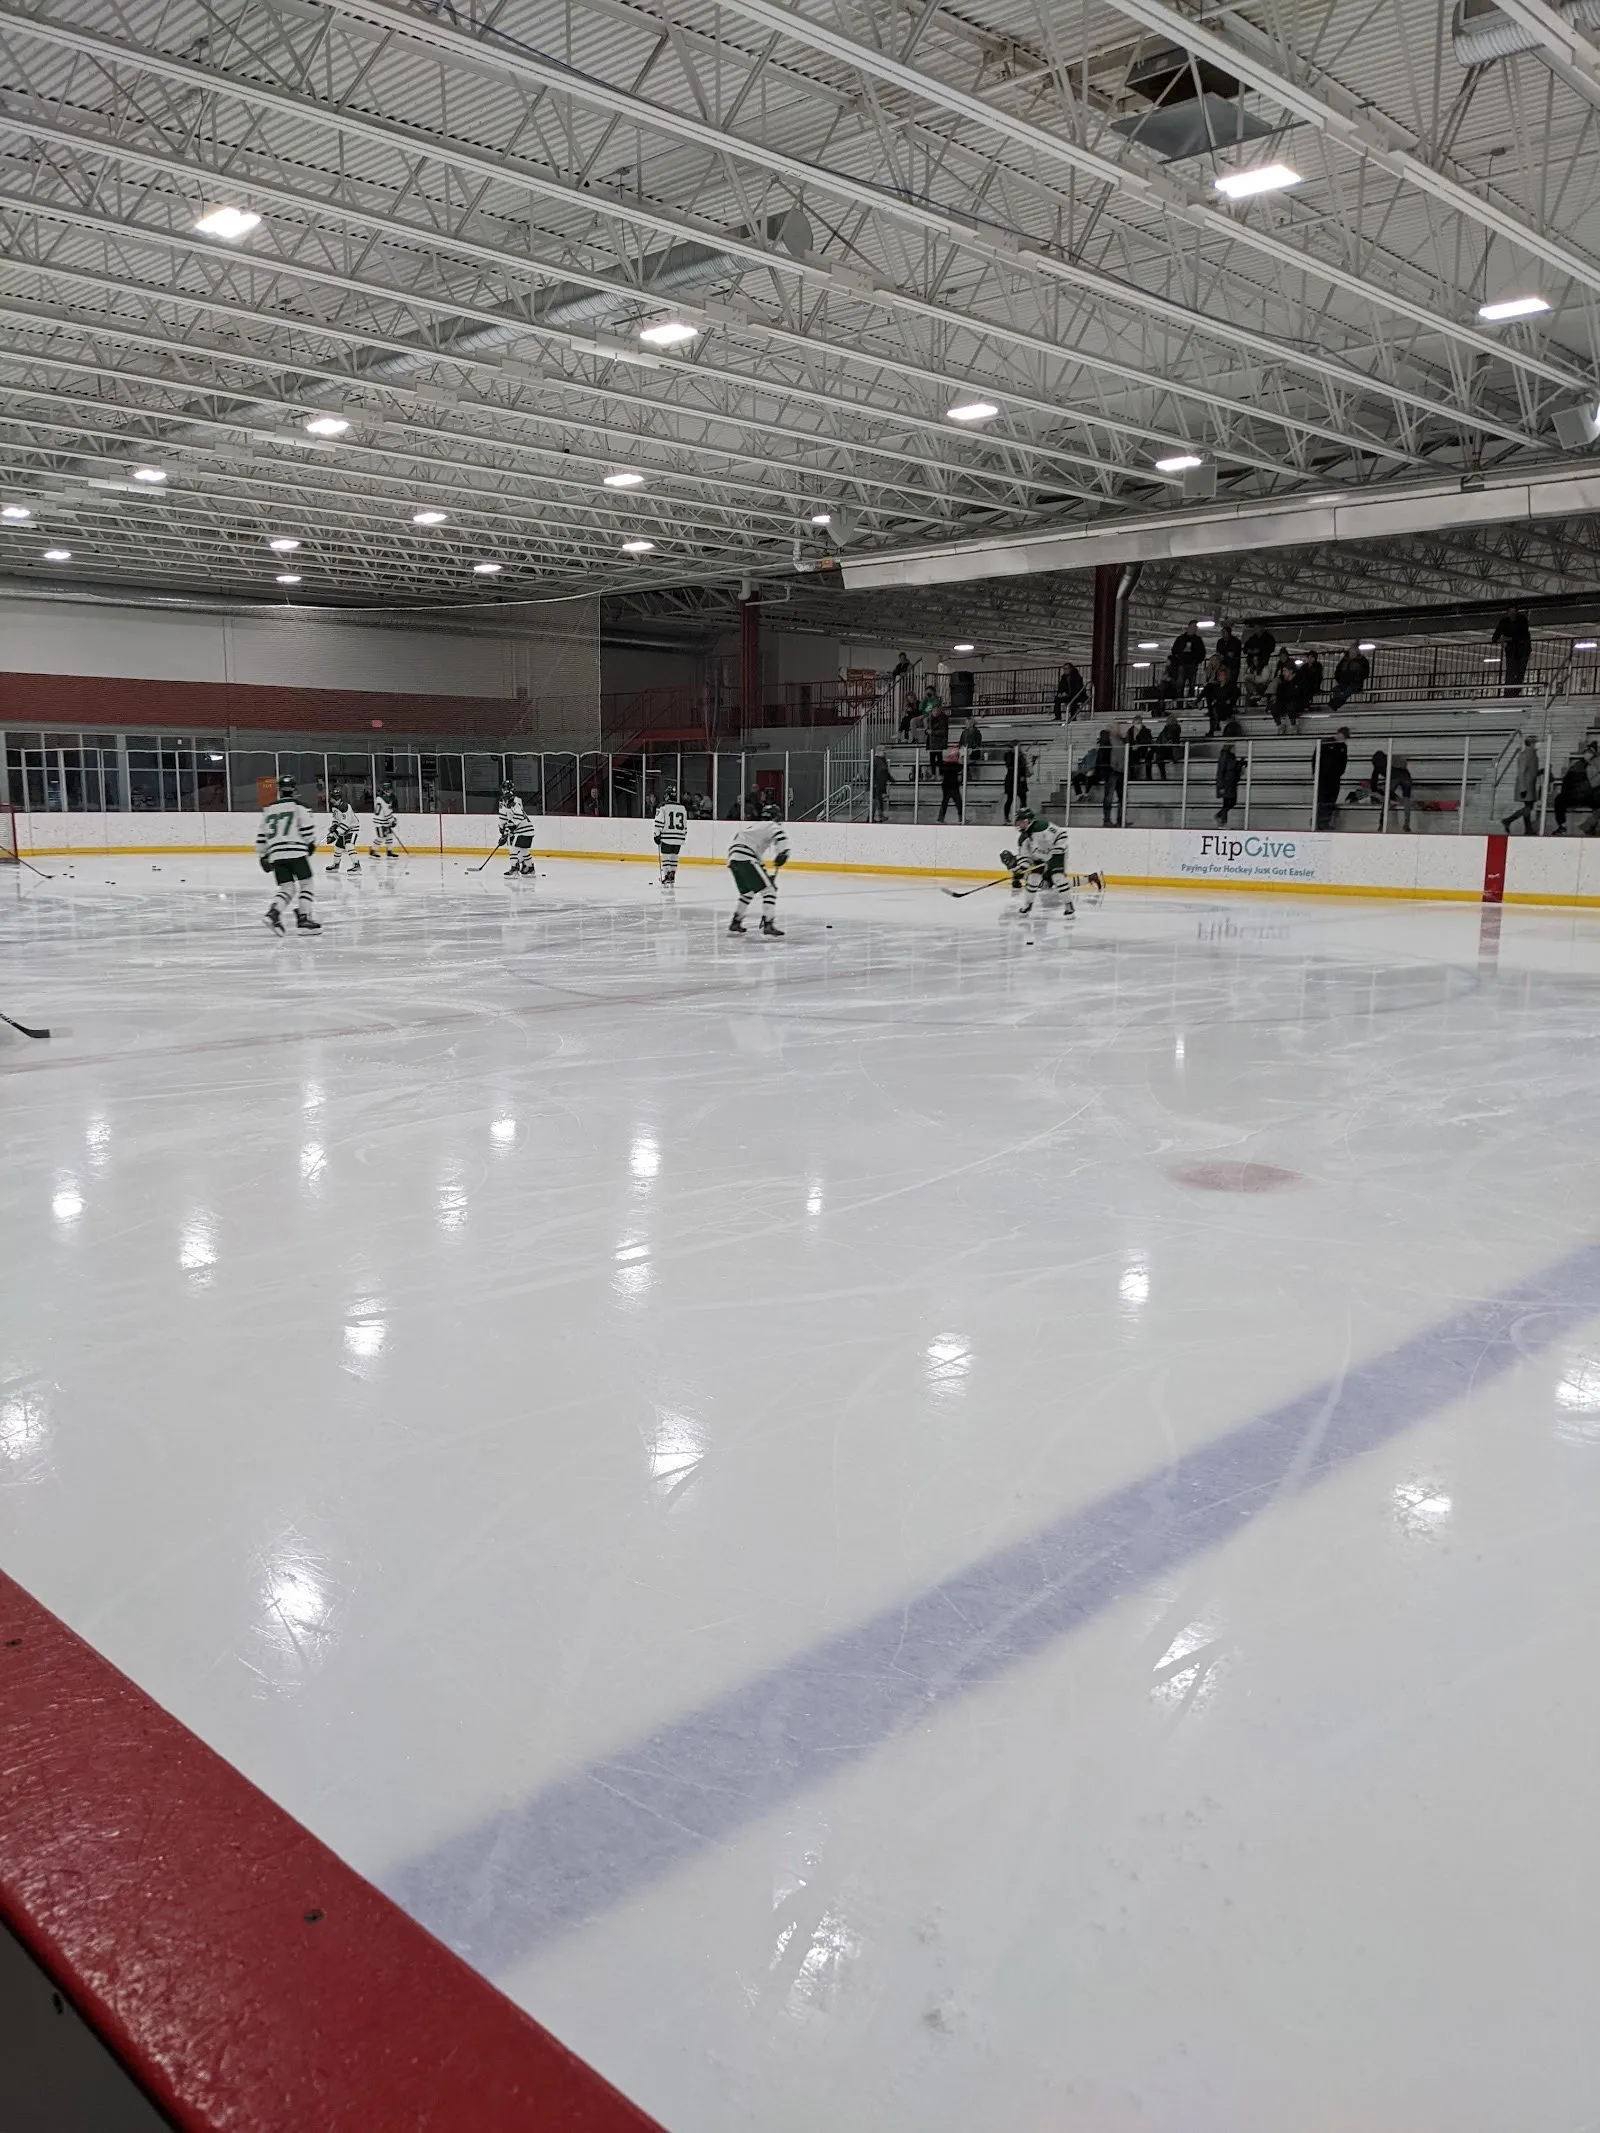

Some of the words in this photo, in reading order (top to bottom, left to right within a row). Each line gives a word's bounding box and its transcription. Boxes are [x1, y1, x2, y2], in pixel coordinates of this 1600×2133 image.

[265, 811, 295, 840] 37
[668, 811, 685, 830] 13
[1200, 835, 1296, 861] FlipGive
[1181, 864, 1208, 874] Paying
[1209, 864, 1222, 873] For
[1223, 865, 1253, 875] Hockey
[1254, 867, 1271, 875] Just
[1272, 867, 1287, 876] Got
[1289, 867, 1315, 877] Easier
